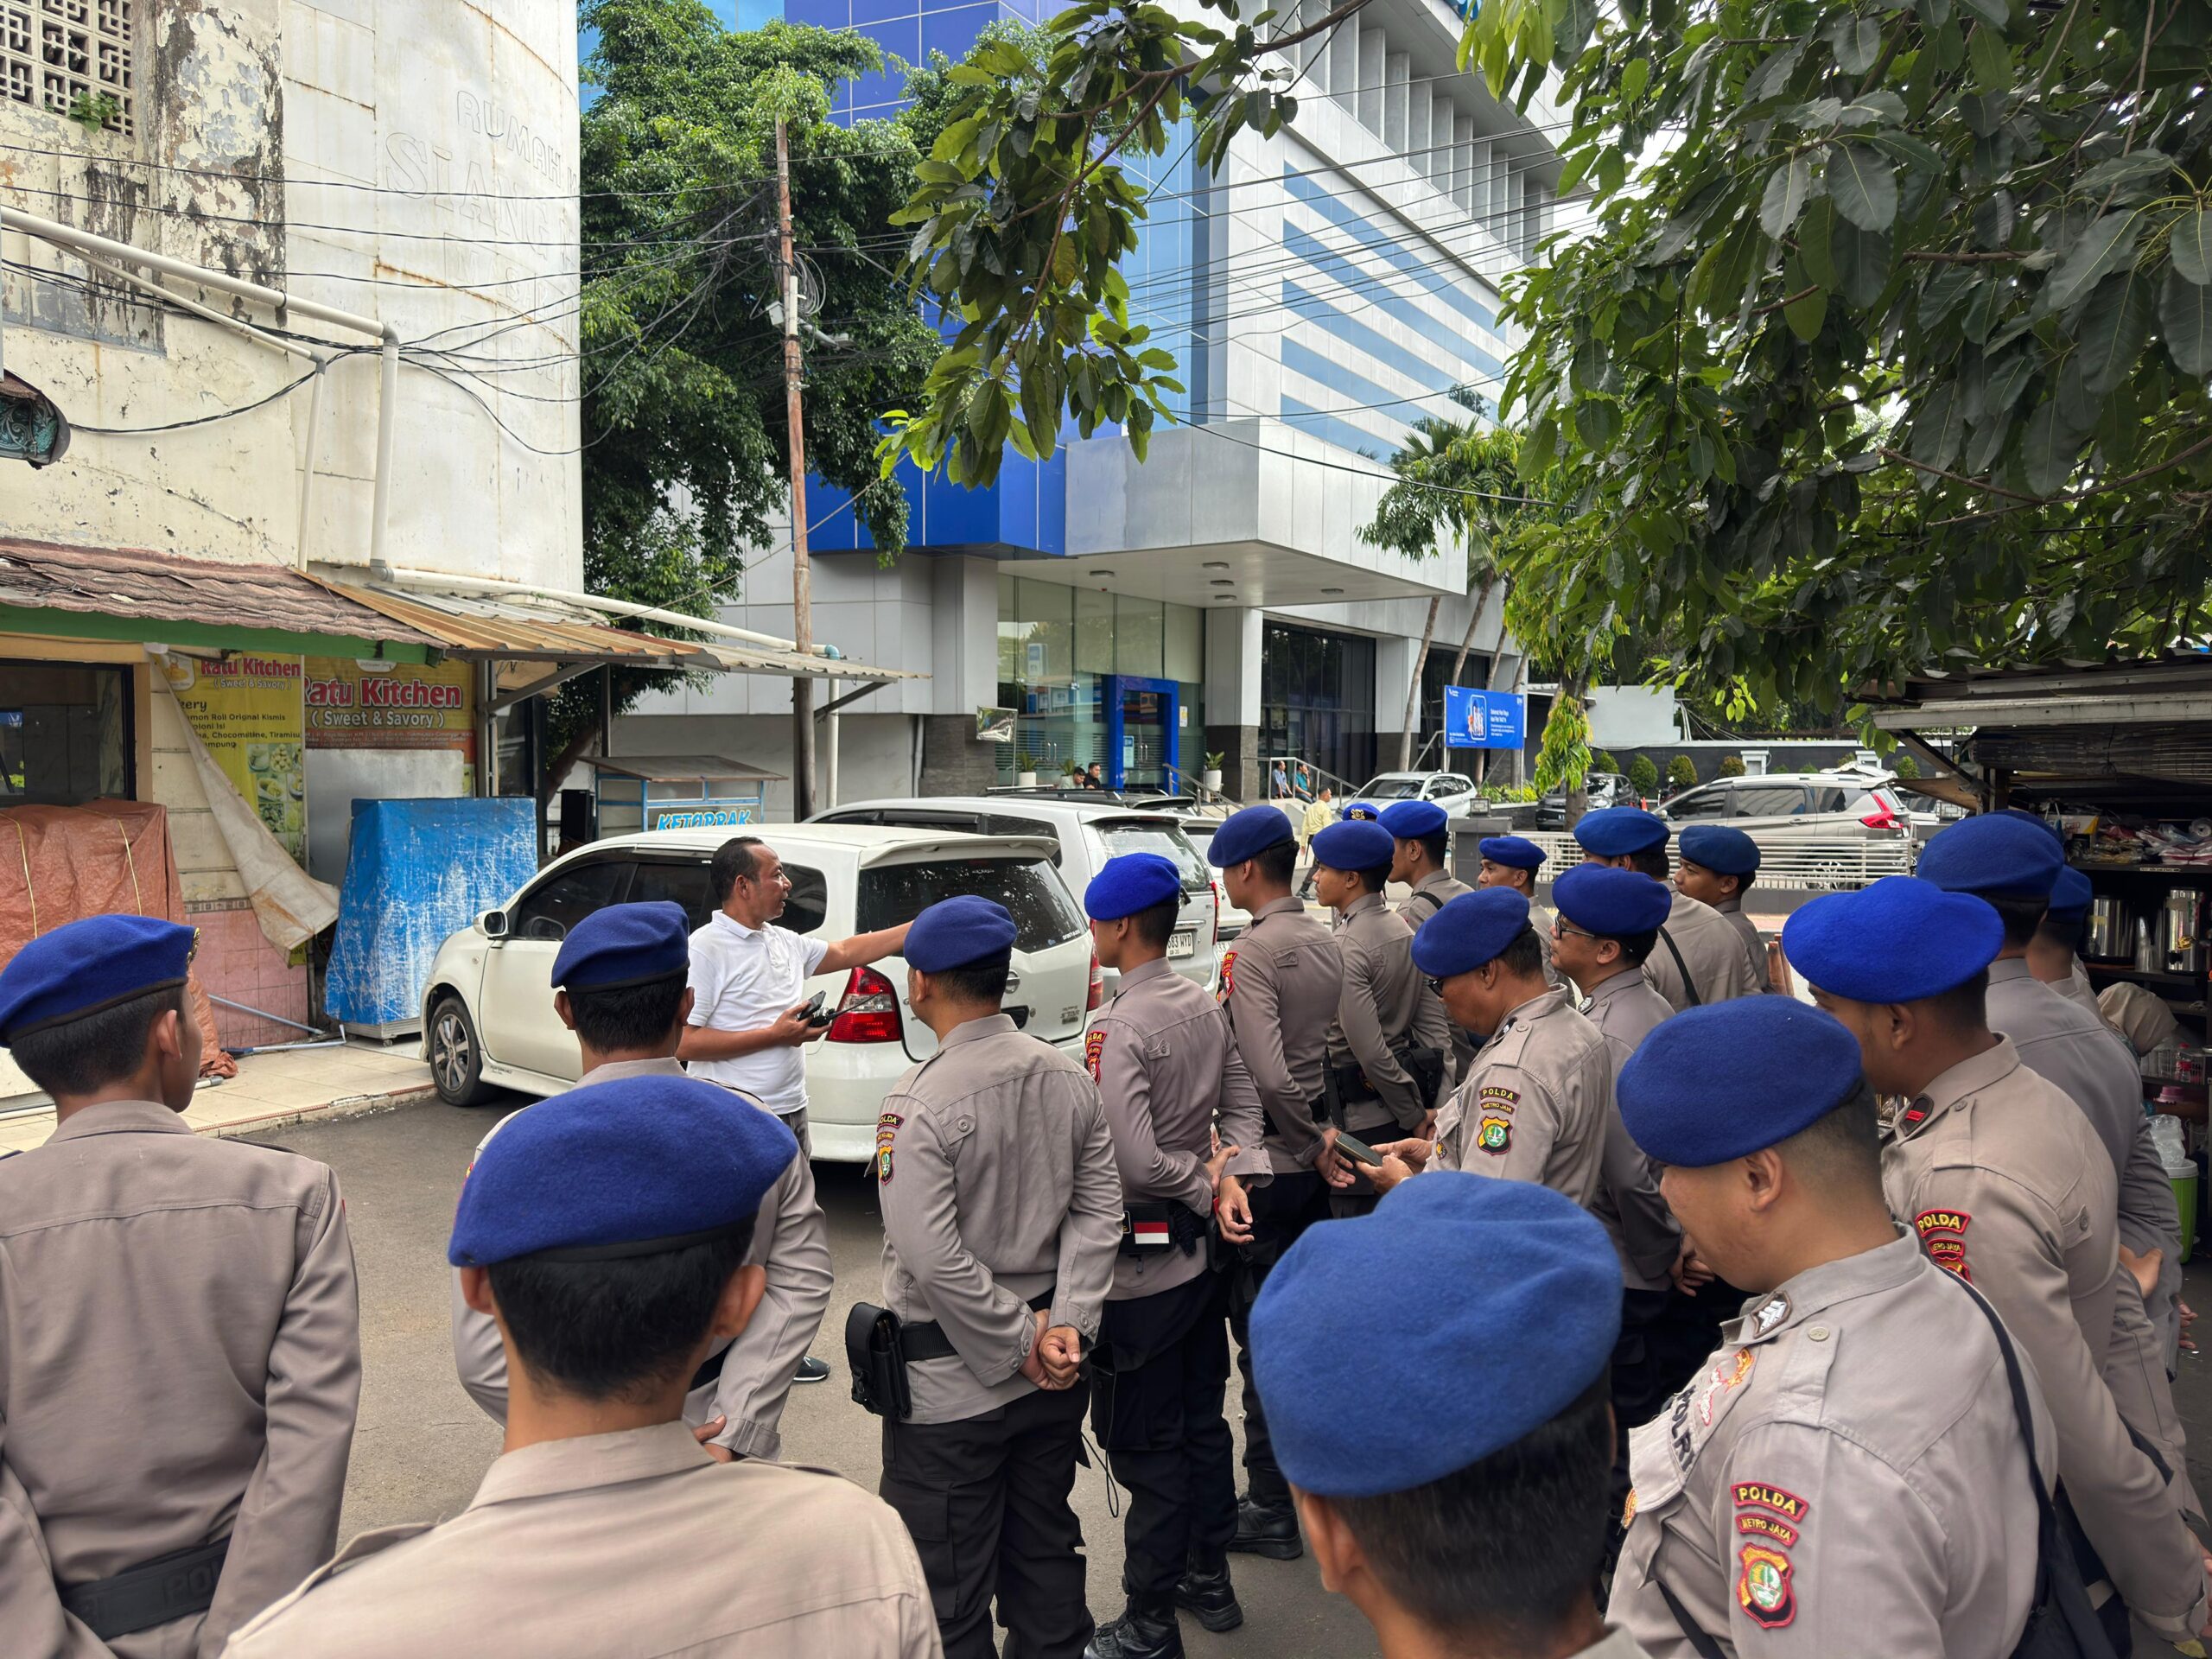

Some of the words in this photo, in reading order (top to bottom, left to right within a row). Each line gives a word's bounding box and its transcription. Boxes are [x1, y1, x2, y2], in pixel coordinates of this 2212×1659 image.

[457, 90, 561, 188] RUMAH
[243, 658, 302, 677] Kitchen
[220, 678, 245, 688] Sweet
[257, 680, 285, 690] Savory
[359, 677, 462, 708] Kitchen
[324, 710, 368, 726] Sweet
[372, 711, 382, 726] &
[386, 711, 433, 728] Savory
[657, 809, 753, 830] KETOPRAK
[1180, 934, 1192, 947] WYD
[1483, 1089, 1513, 1099] POLDA
[880, 1115, 897, 1125] OLDA
[1918, 1213, 1961, 1233] POLDA
[1738, 1486, 1796, 1516] POLDA
[1741, 1517, 1767, 1530] METRO
[1769, 1522, 1791, 1541] JAYA
